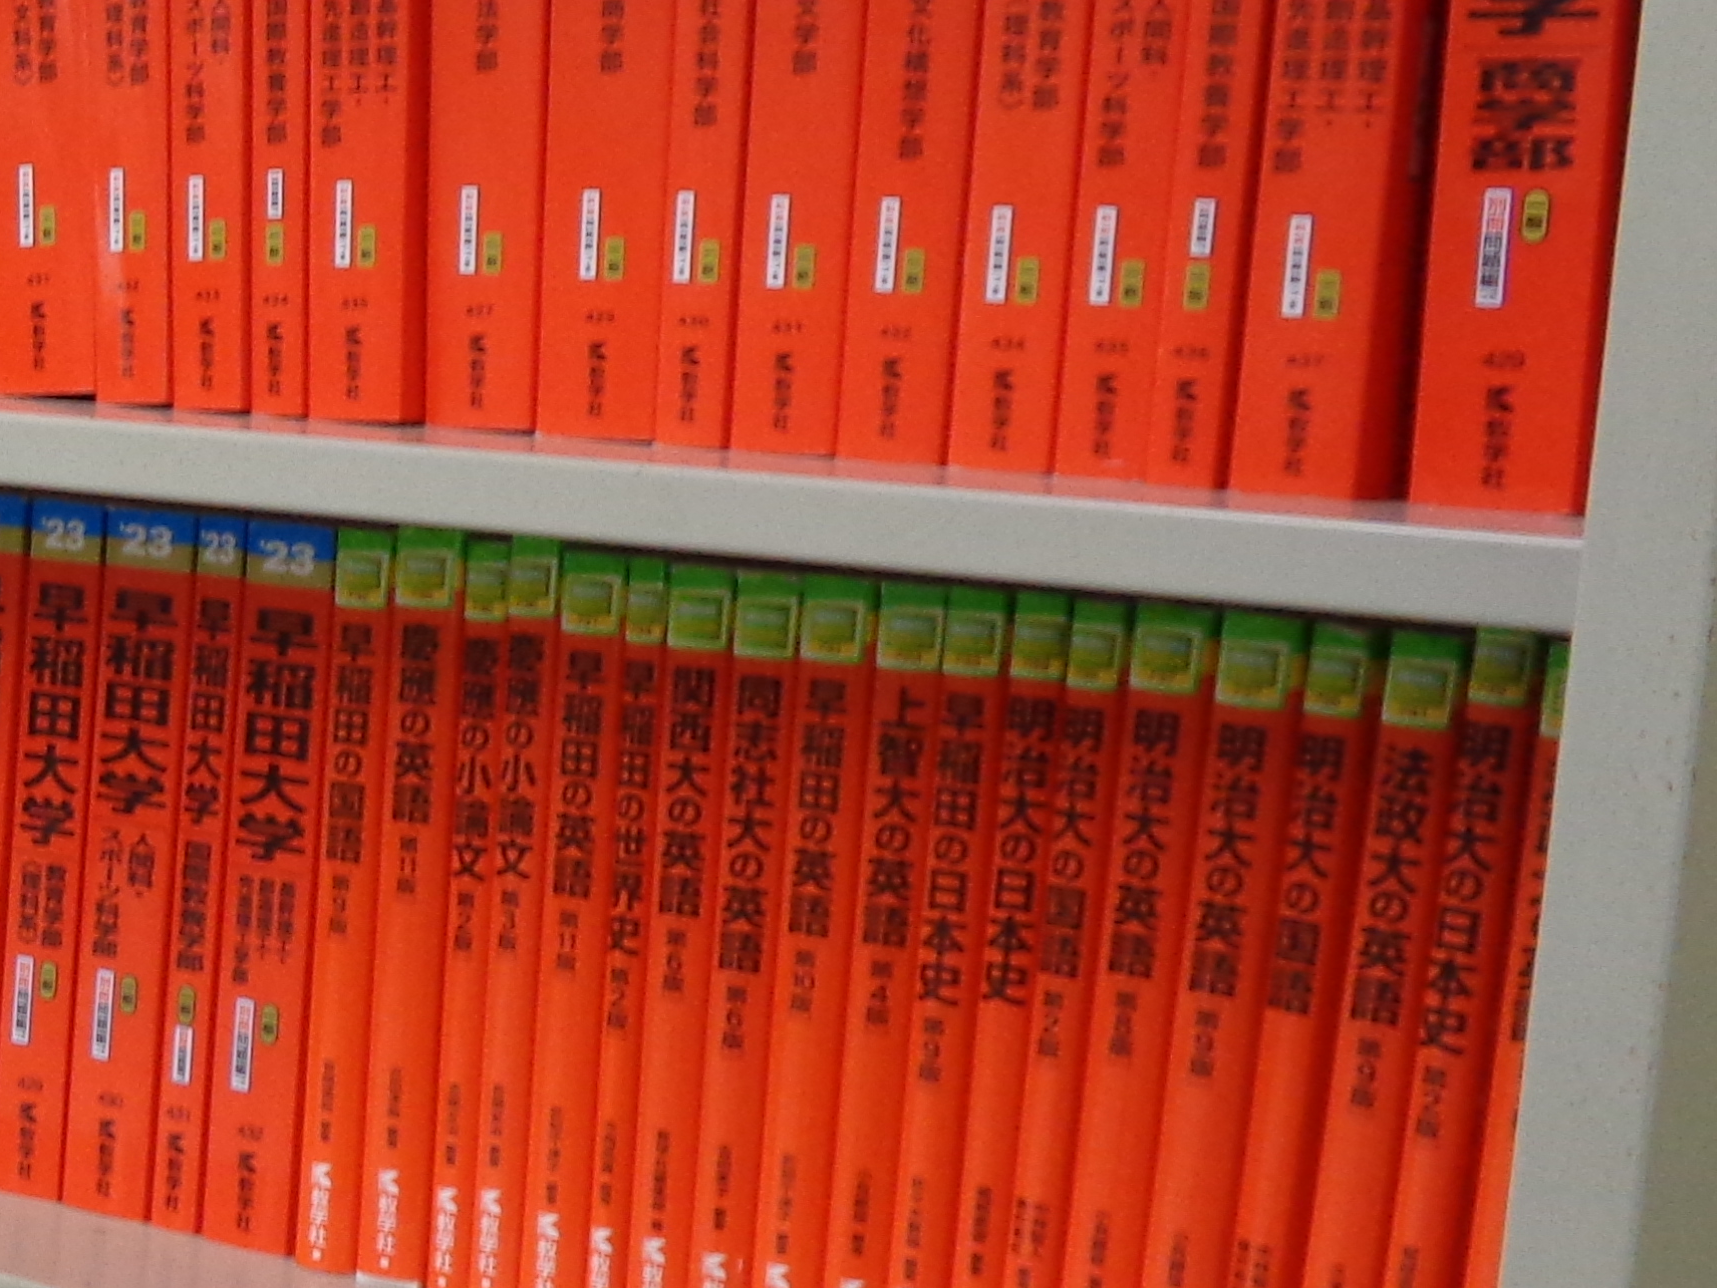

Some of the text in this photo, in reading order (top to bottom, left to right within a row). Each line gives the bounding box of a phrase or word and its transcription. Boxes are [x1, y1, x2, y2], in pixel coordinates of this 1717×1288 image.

[553, 648, 604, 901] 早稲田の英語
[607, 660, 656, 957] 早稲田の世界史
[659, 666, 717, 919] 関西大の英語
[718, 674, 784, 973] 同志社大の英語
[863, 686, 926, 947] 上智大の英語
[981, 695, 1057, 1006] 明治大の日本史
[1040, 708, 1104, 979] 明治大の国語
[1108, 709, 1181, 983] 明治大の英語
[1188, 721, 1267, 998] 明治大の英語
[1350, 745, 1430, 1026] 法政大の英語
